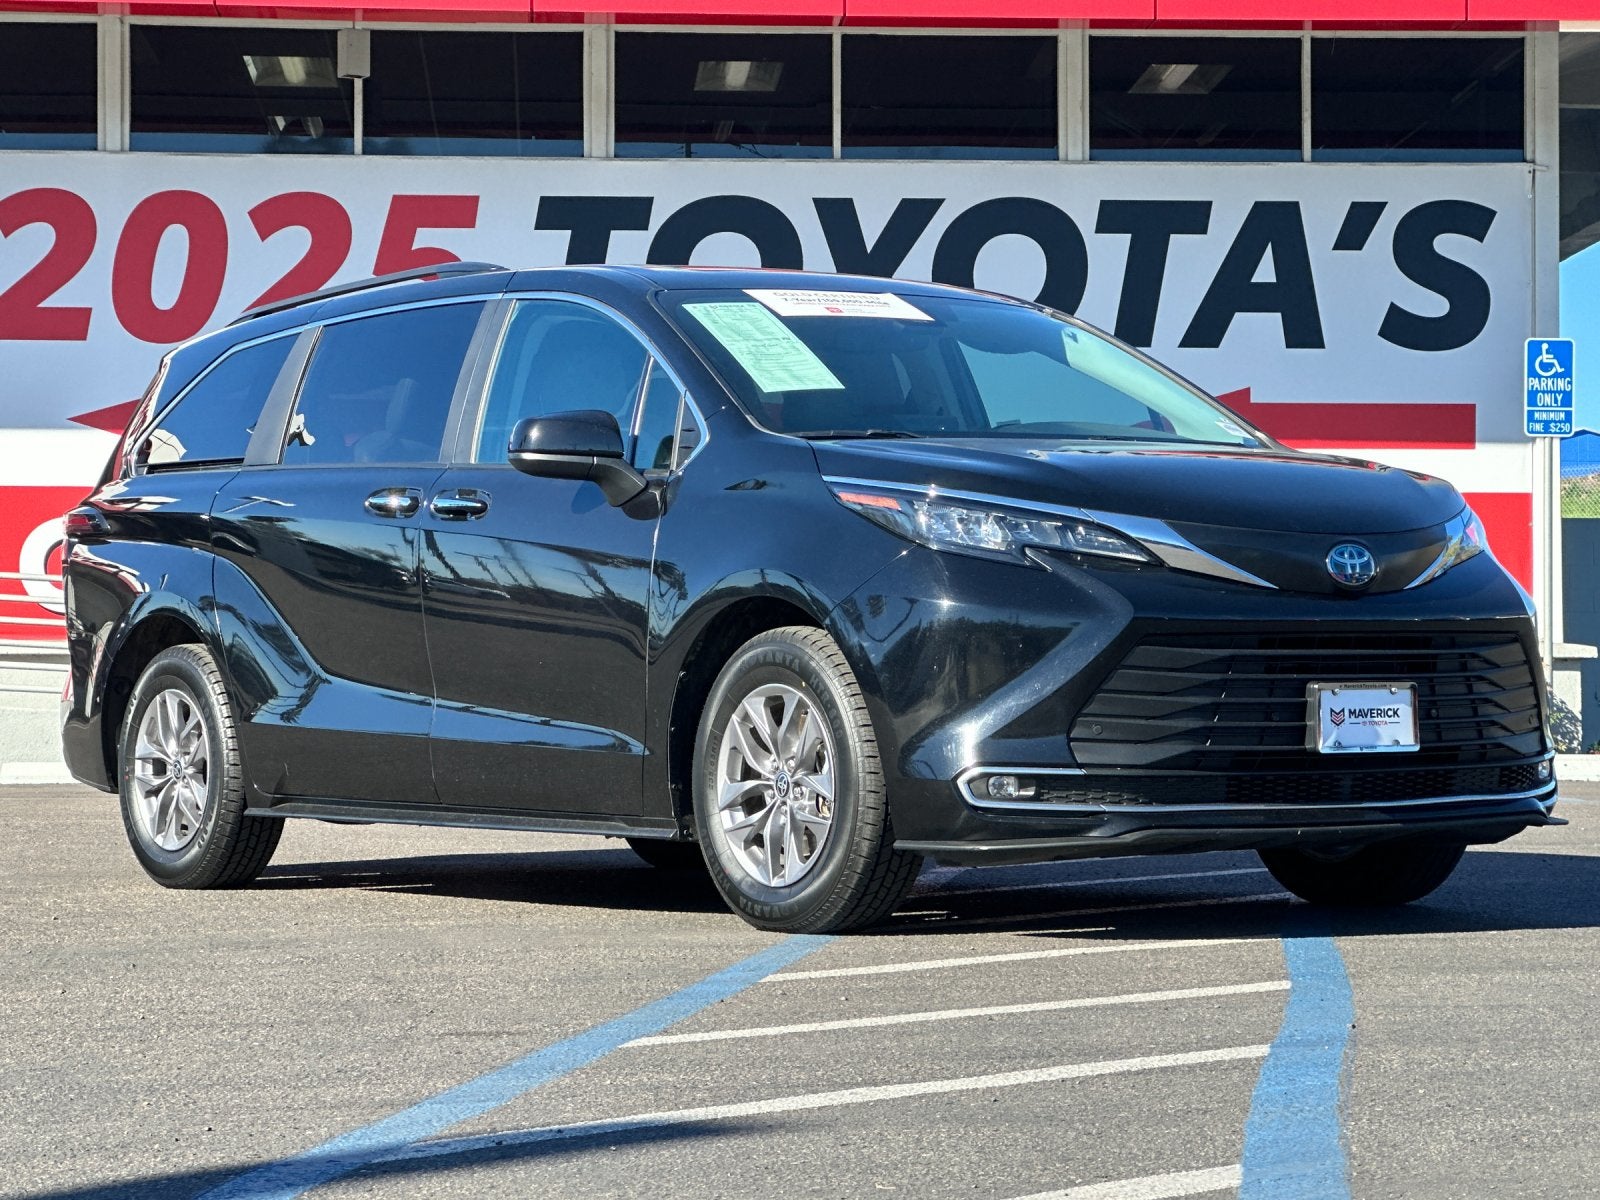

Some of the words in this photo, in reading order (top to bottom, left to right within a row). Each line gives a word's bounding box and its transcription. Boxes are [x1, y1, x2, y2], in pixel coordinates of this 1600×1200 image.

[0, 189, 478, 342] 2025
[1528, 377, 1572, 391] PARKING
[1537, 393, 1563, 407] ONLY
[1534, 411, 1565, 420] MINIMUM
[1529, 422, 1545, 432] FINE
[1549, 422, 1571, 433] $250
[1348, 707, 1400, 719] MAVERICK
